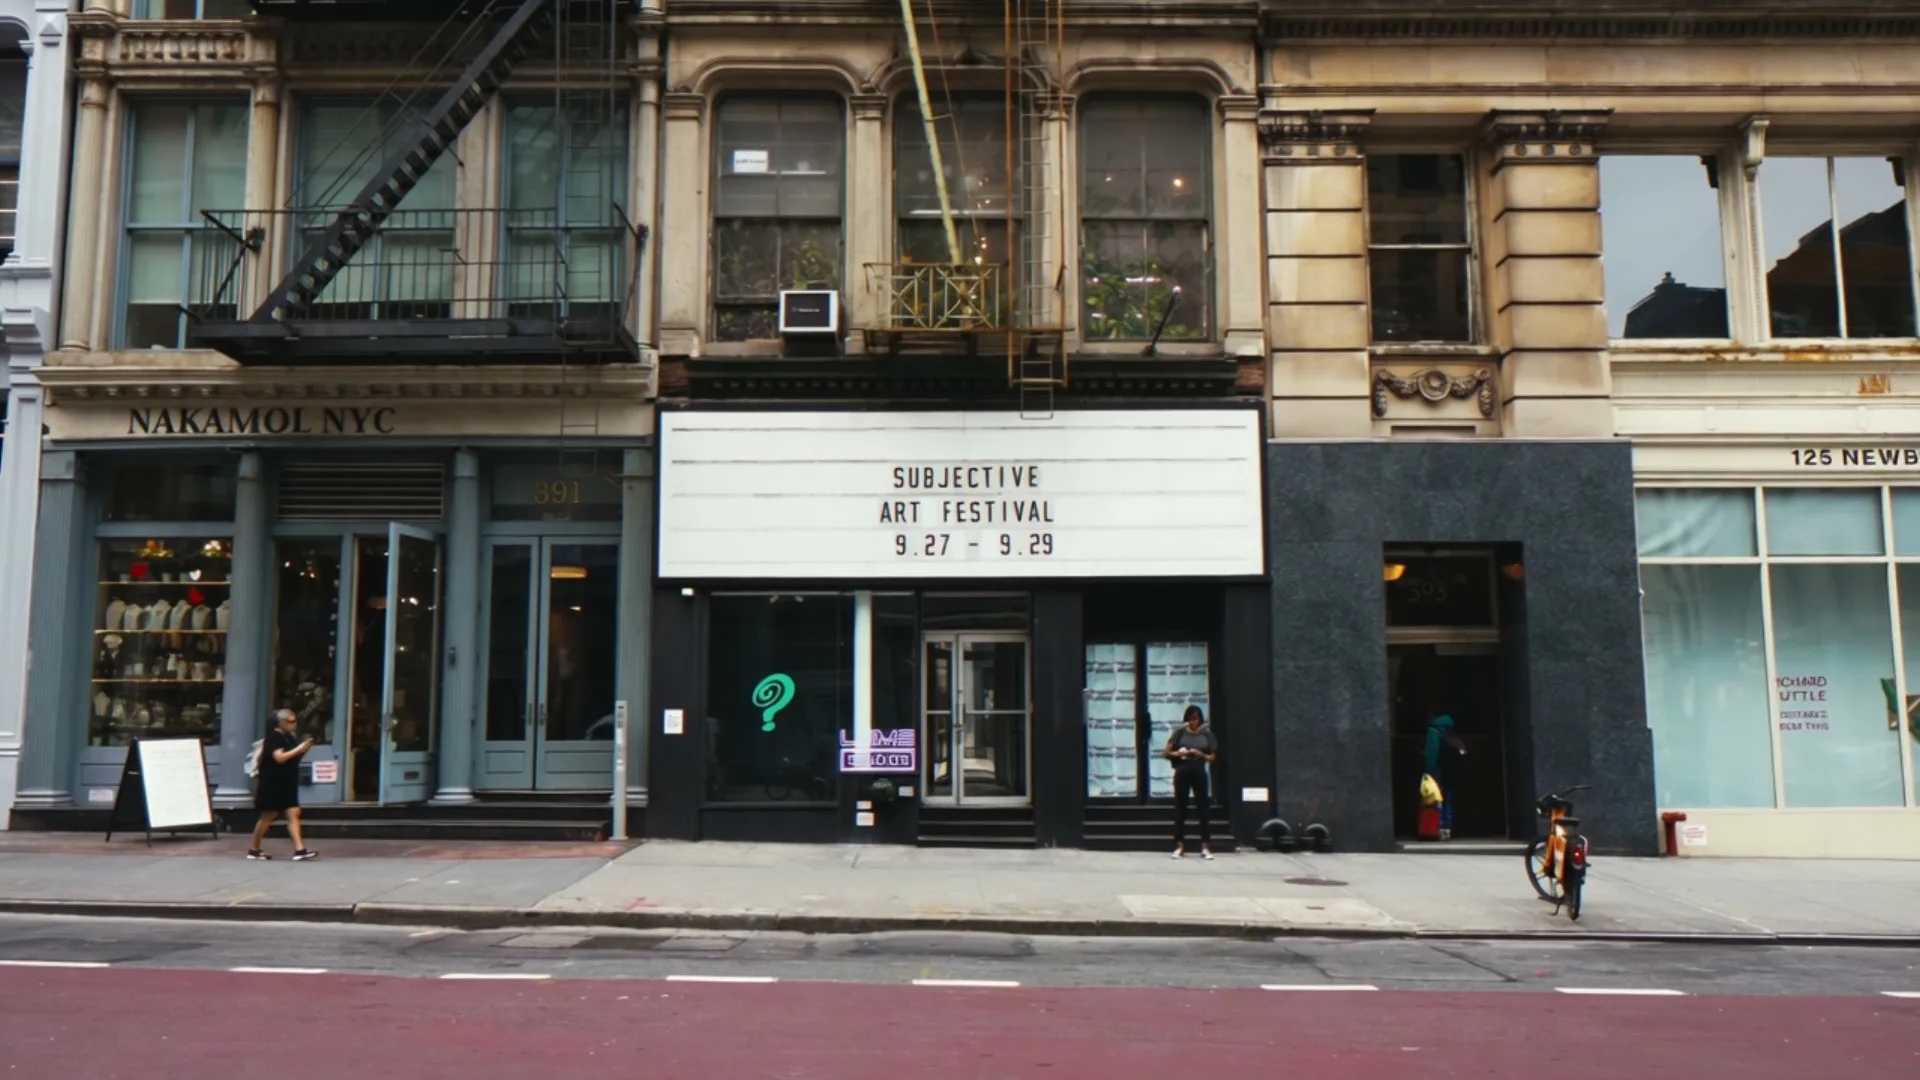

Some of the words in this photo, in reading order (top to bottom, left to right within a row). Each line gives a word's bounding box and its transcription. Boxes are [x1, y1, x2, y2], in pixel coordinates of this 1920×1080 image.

[127, 408, 312, 435] NAKAMOL
[322, 408, 397, 434] NYC
[1791, 449, 1833, 466] 125
[893, 466, 1039, 489] SUBJECTIVE
[533, 480, 581, 504] 391
[880, 501, 921, 523] ART
[943, 501, 1054, 523] FESTIVAL
[895, 534, 950, 556] 9.27
[1000, 533, 1054, 556] 9.29
